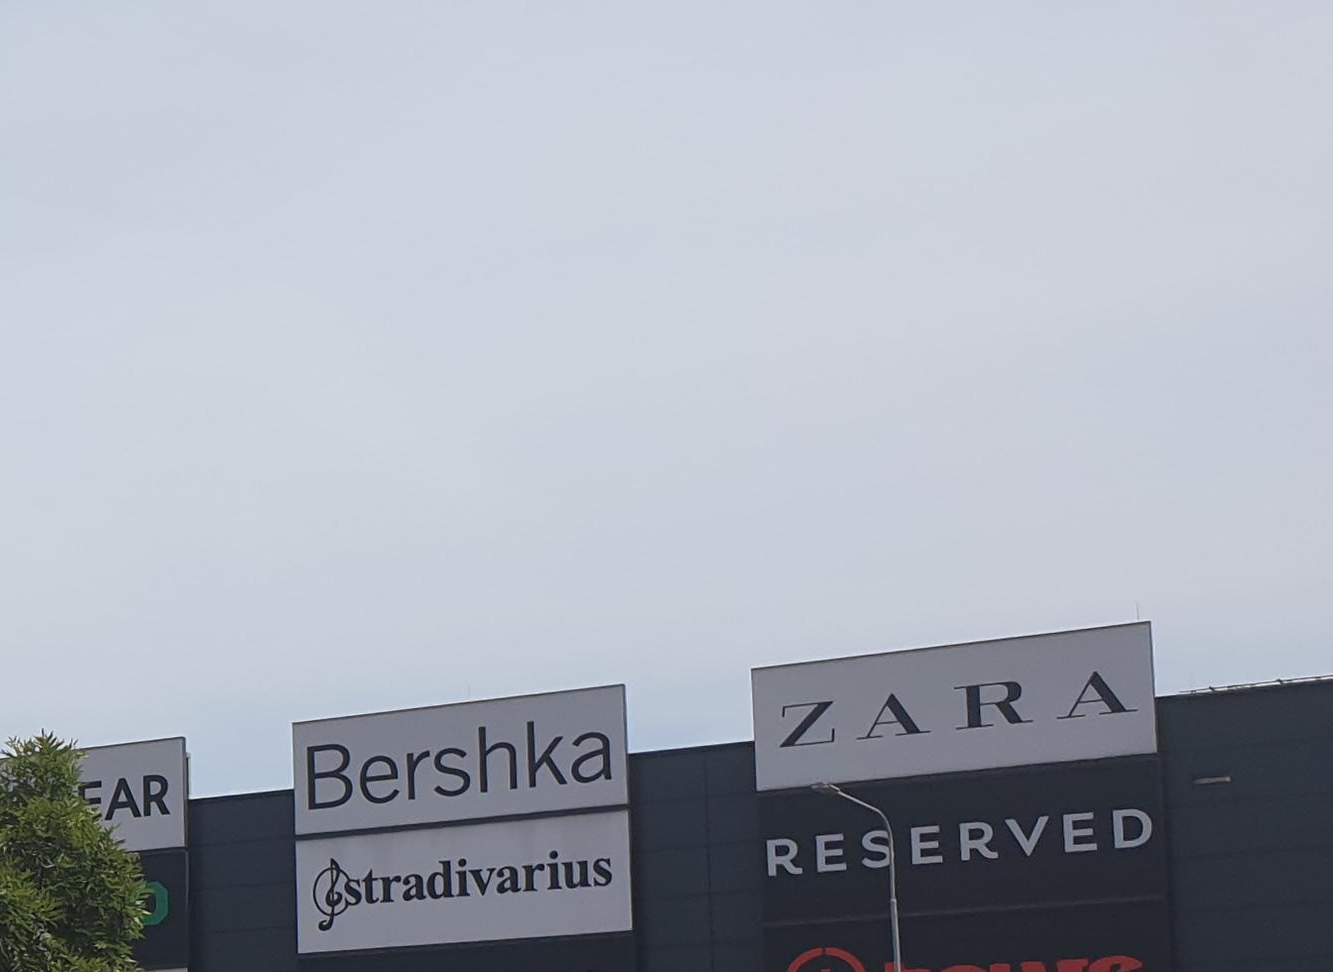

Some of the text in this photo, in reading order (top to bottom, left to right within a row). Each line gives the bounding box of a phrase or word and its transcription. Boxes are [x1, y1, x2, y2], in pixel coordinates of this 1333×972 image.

[780, 670, 1138, 749] ZARA
[306, 719, 614, 811] Bershka
[344, 850, 613, 906] stradivarius
[765, 808, 1154, 877] RESERVED
